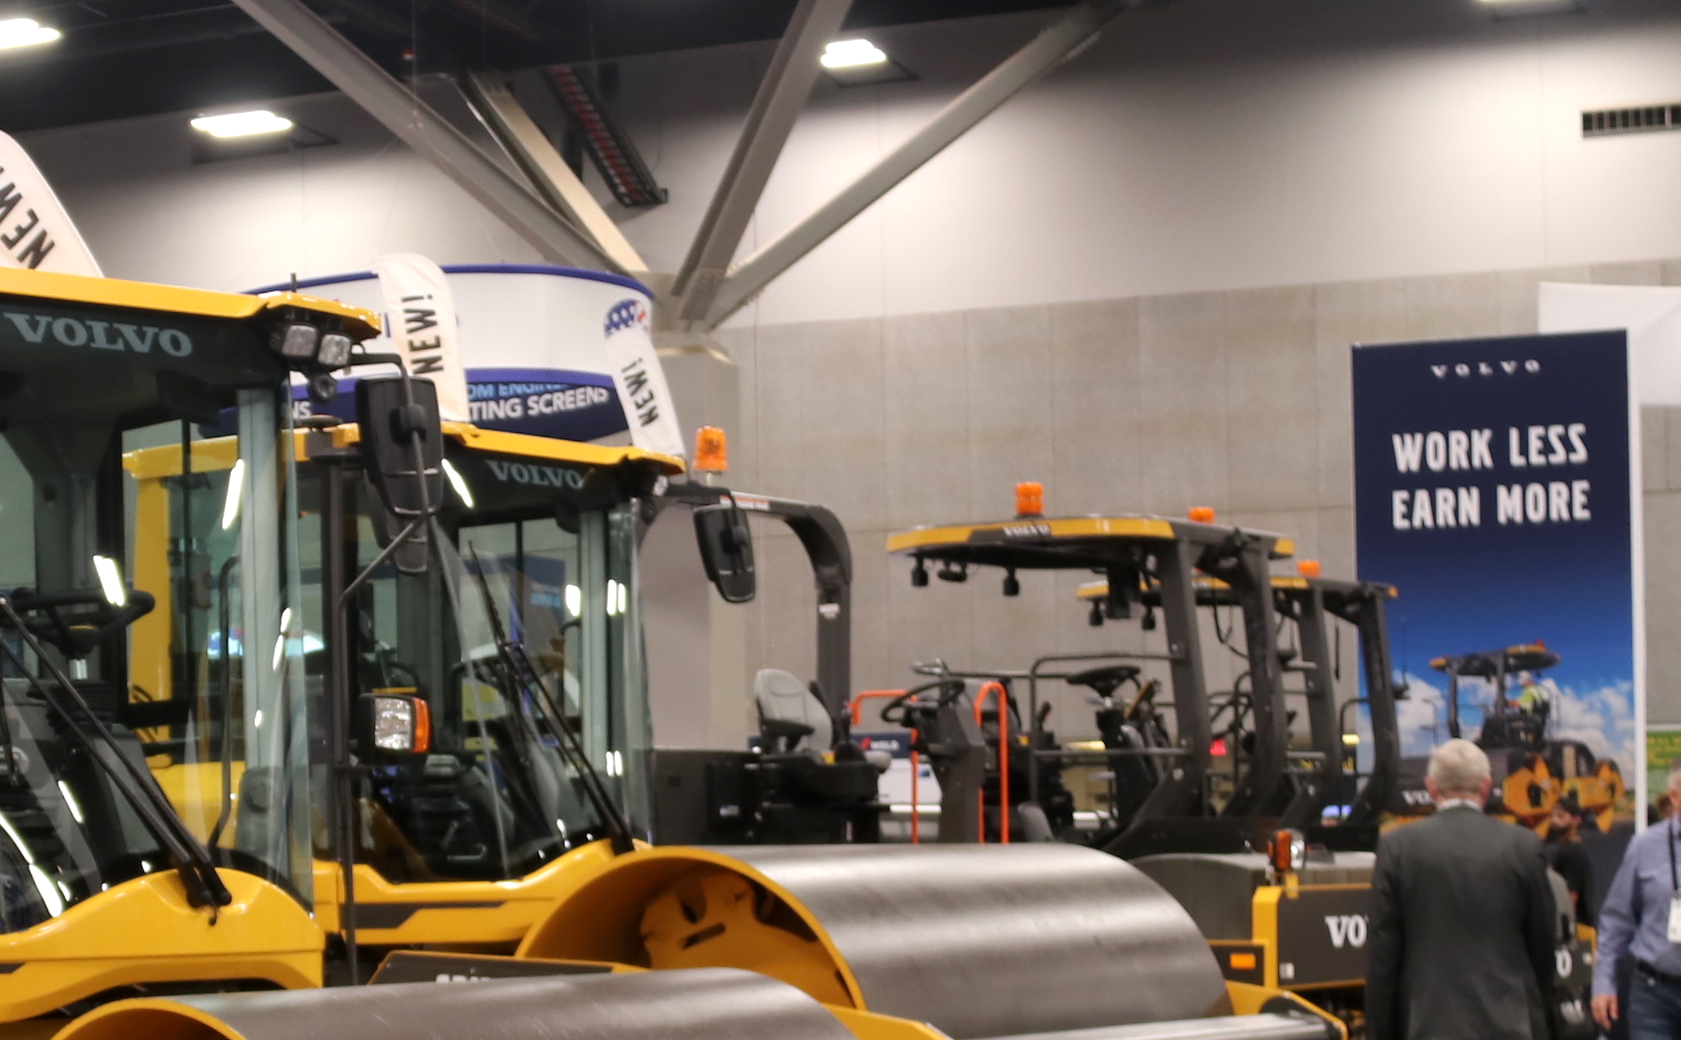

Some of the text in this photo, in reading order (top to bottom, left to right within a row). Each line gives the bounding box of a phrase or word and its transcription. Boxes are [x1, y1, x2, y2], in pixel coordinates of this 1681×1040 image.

[3, 312, 193, 358] VOLVO
[402, 293, 444, 374] NEW!
[622, 356, 659, 427] NEW!
[1430, 359, 1541, 379] VOLVO
[1391, 422, 1589, 474] WORK LESS
[485, 459, 584, 490] VOLVO
[1391, 479, 1592, 531] EARN MORE
